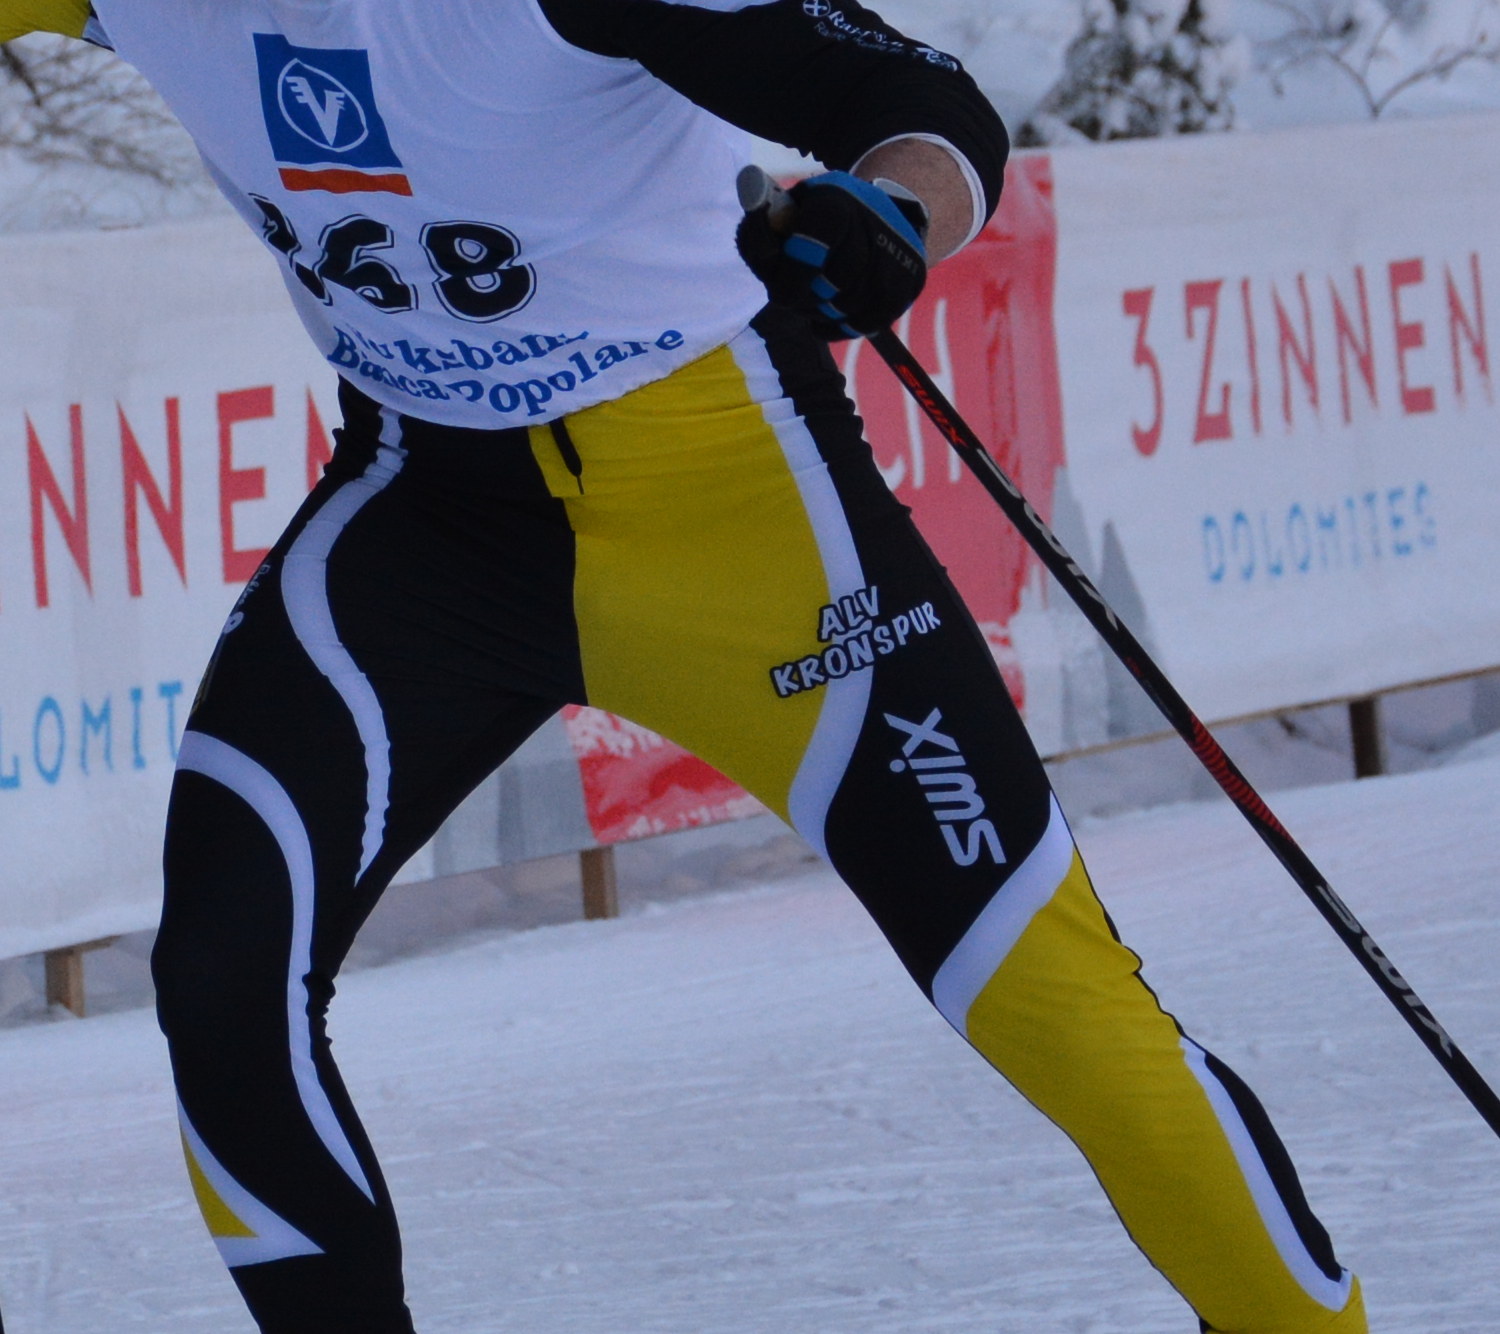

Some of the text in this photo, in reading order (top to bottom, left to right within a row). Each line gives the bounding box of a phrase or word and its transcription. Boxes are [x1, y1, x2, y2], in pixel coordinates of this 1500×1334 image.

[1121, 284, 1164, 459] 3
[1183, 251, 1493, 446] ZINNEN
[771, 601, 941, 698] KRONSPUR
[819, 586, 880, 642] ALV
